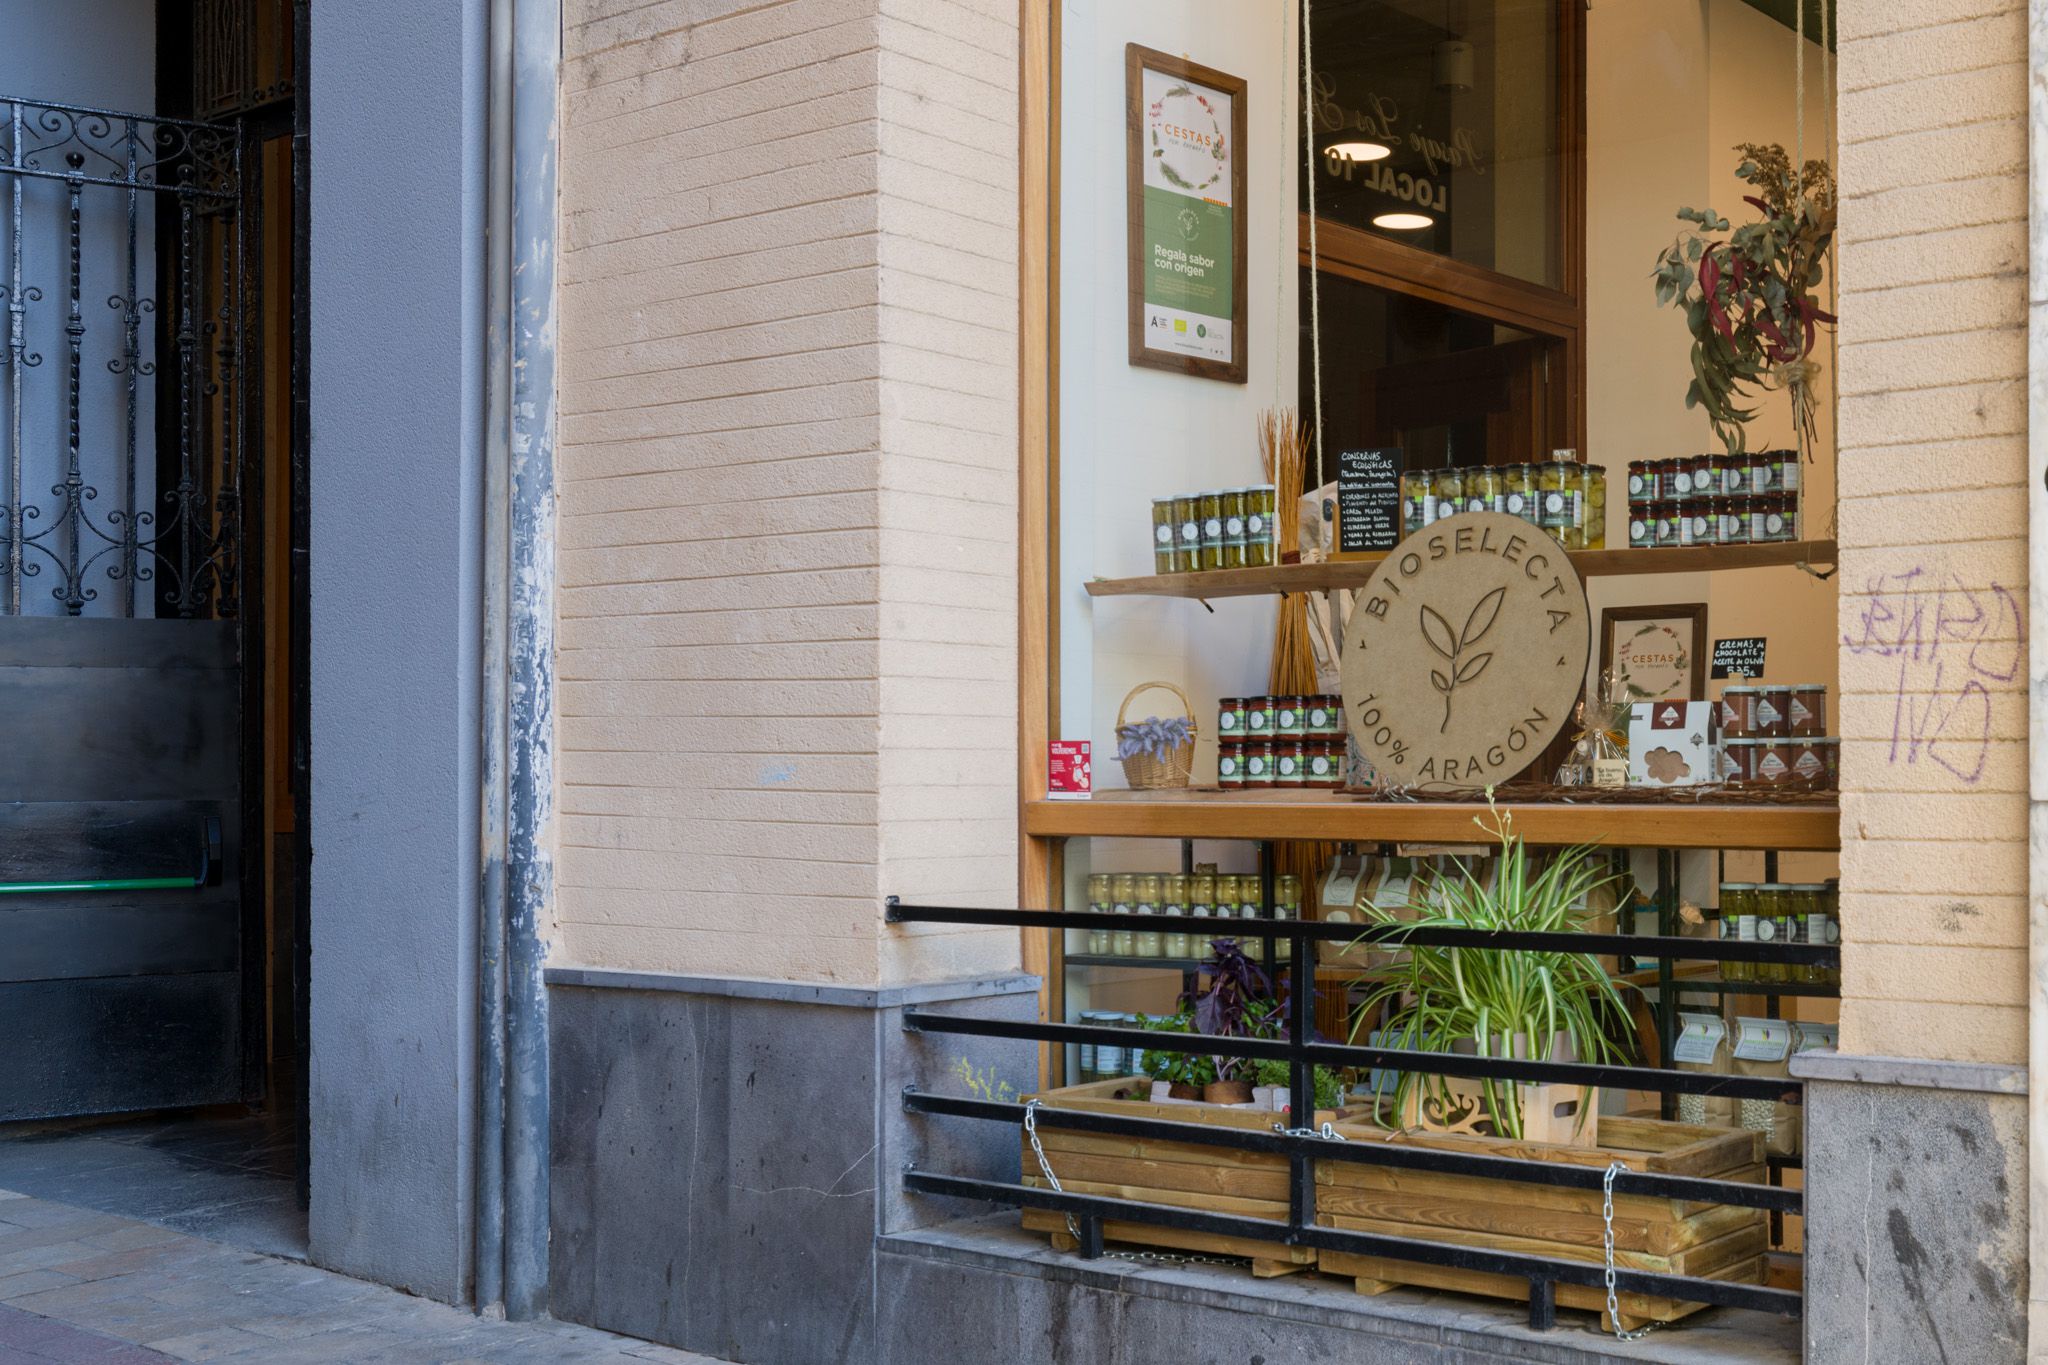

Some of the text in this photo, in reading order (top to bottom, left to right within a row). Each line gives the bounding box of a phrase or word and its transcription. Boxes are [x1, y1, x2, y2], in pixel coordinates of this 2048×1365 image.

[1165, 124, 1211, 147] CESTAS
[1154, 244, 1215, 268] Regala sabor
[1154, 258, 1204, 277] con origen
[1341, 451, 1381, 461] CONSERVAS
[1365, 527, 1572, 634] BIOSELECTA
[1719, 640, 1754, 649] CREMAS
[1632, 654, 1675, 664] CESTAS
[1715, 649, 1758, 657] CHOCOLATE
[1713, 657, 1734, 666] ACEITE
[1744, 657, 1764, 665] OLIVA
[1357, 693, 1549, 780] 100% ARAGÓN
